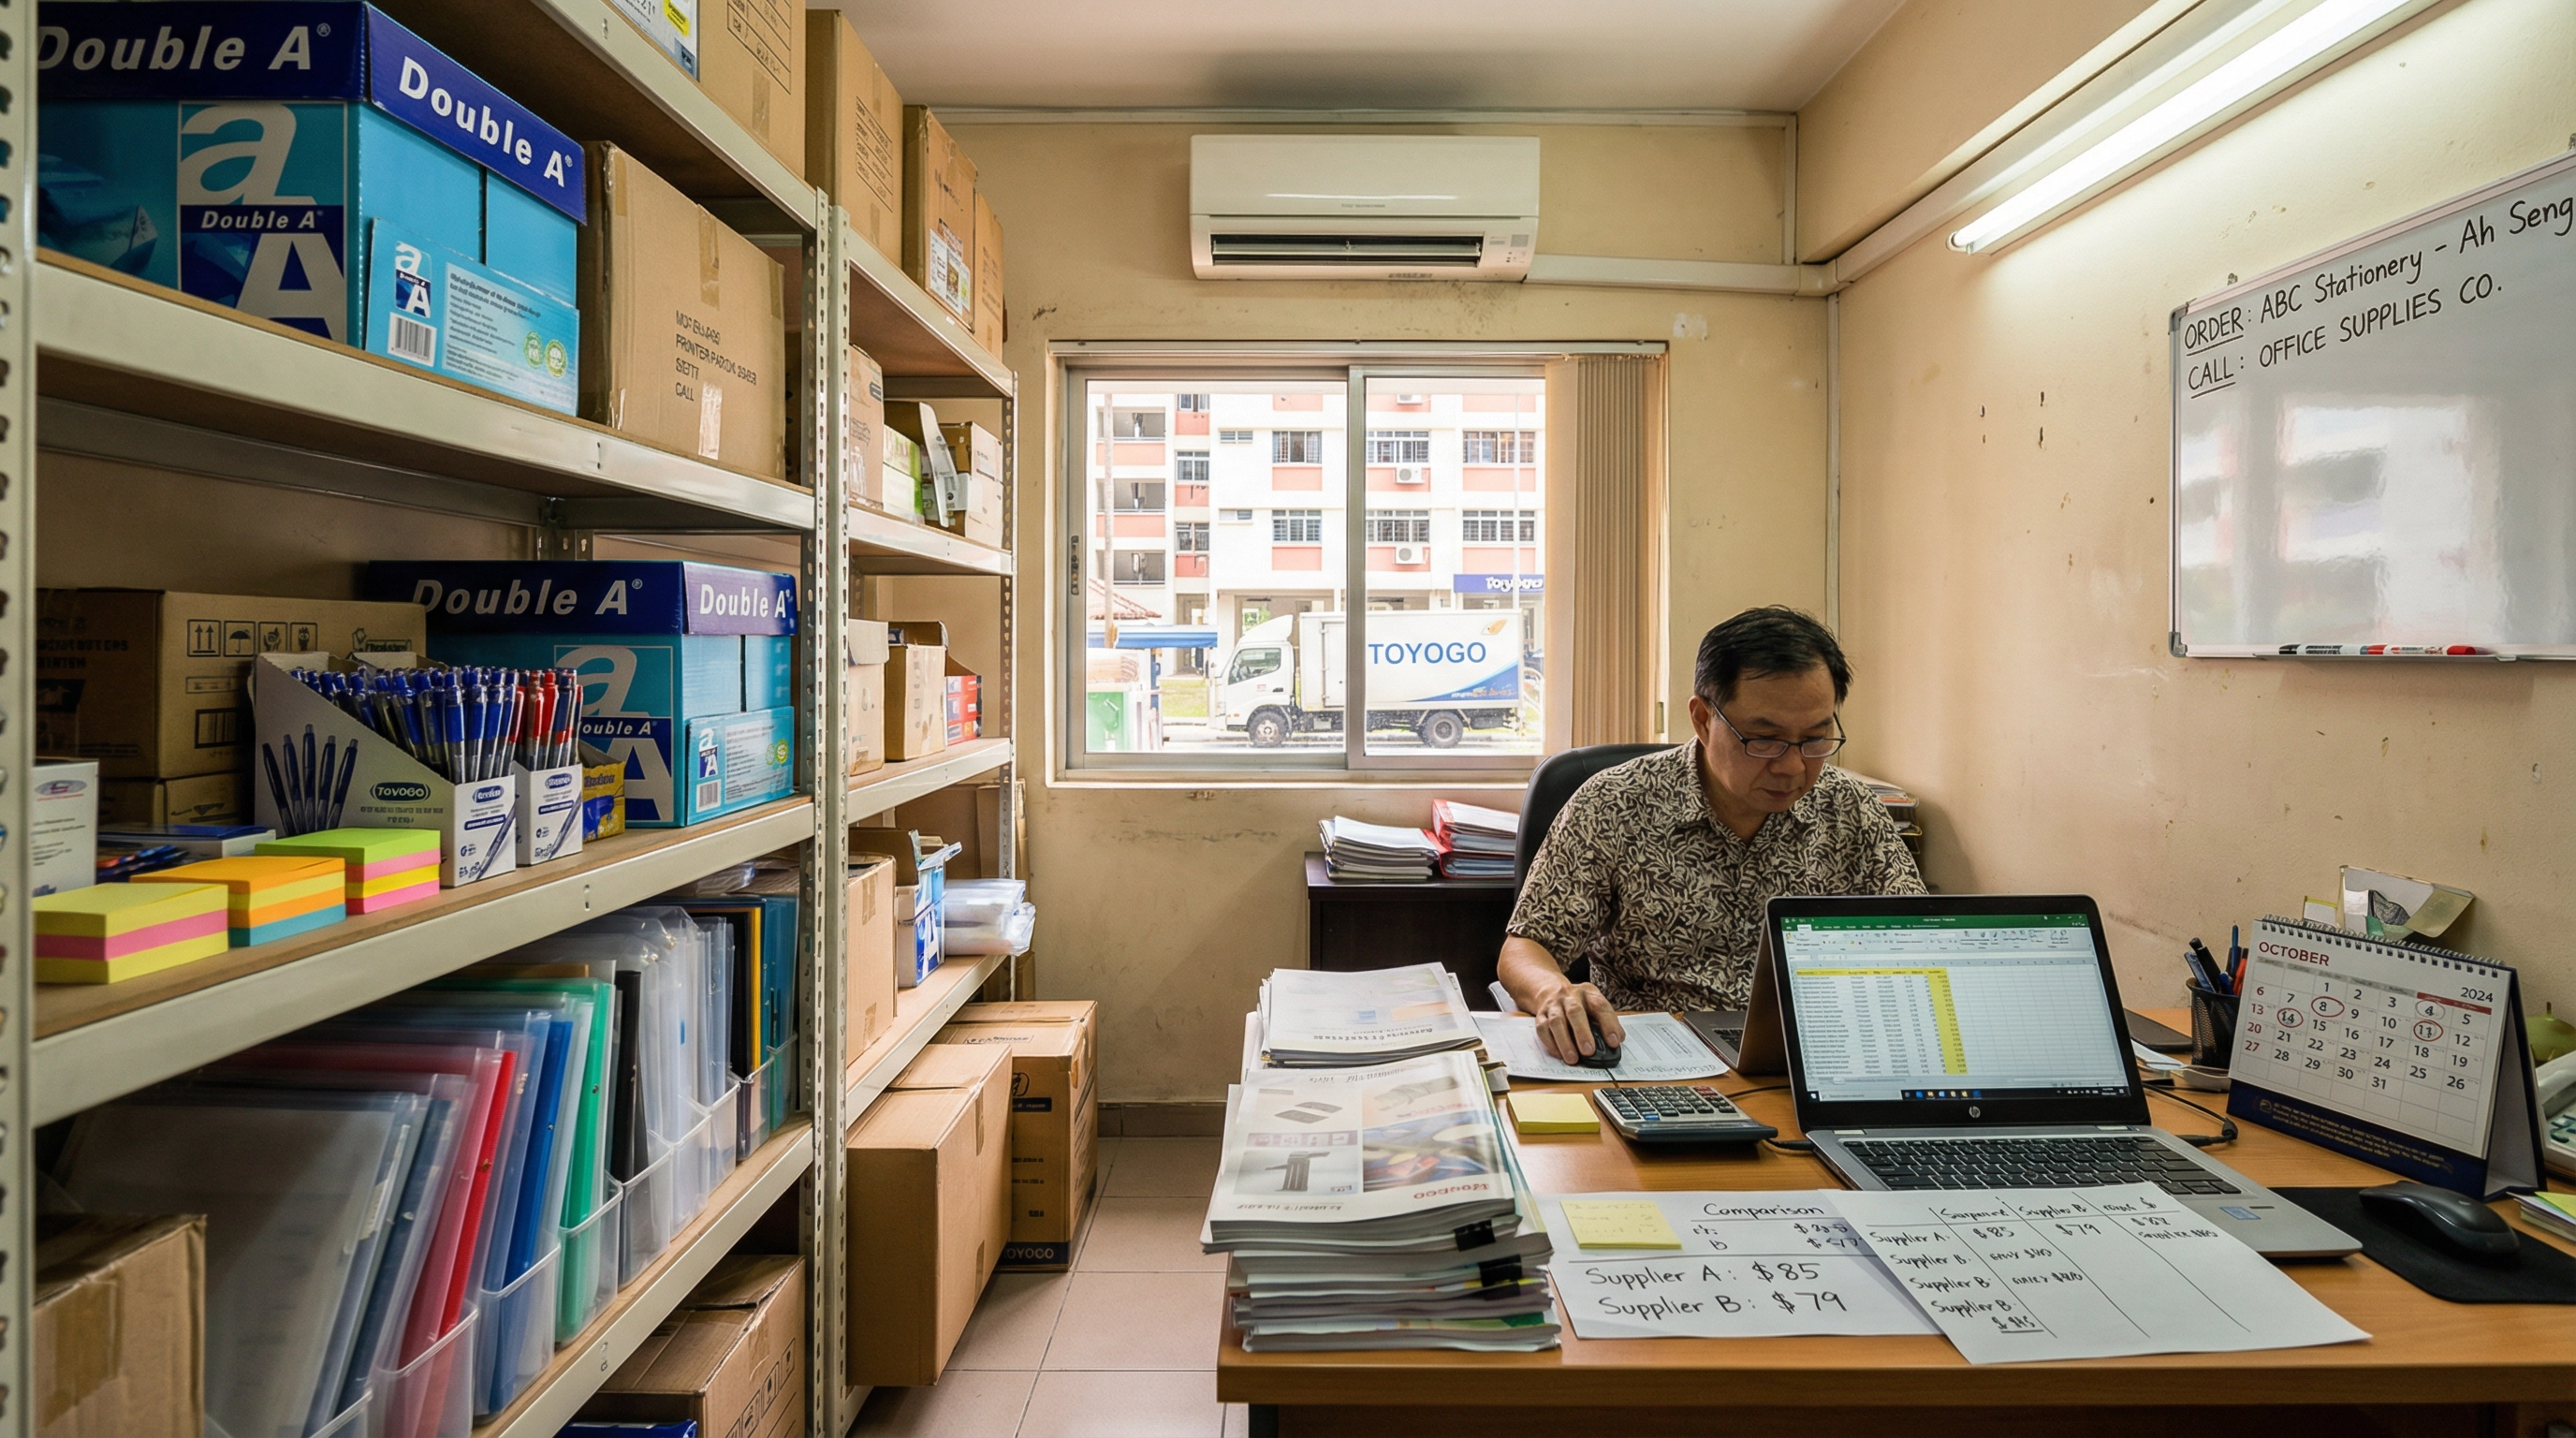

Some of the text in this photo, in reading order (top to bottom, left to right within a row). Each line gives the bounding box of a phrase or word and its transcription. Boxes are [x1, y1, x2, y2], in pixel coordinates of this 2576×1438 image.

[37, 26, 245, 70] Double
[400, 56, 532, 165] Double
[200, 211, 288, 229] Double
[2261, 285, 2302, 323] ABC
[2314, 251, 2422, 303] Stationery
[2460, 215, 2494, 254] Ah
[2510, 198, 2573, 236] Seng
[2260, 326, 2326, 367] OFFICE
[2339, 288, 2441, 342] SUPPLIES
[2459, 273, 2502, 304] CO.
[413, 580, 578, 615] Double
[699, 584, 768, 618] Double
[1368, 641, 1486, 665] TOYOGO
[580, 721, 634, 735] ouble
[2259, 942, 2330, 966] OCTOBER
[2324, 983, 2329, 992] 1
[2353, 990, 2362, 1000] 2
[2388, 997, 2396, 1007] 3
[2462, 1014, 2471, 1025] 5
[2460, 987, 2494, 1003] 2024
[2257, 987, 2264, 996] 6
[2287, 993, 2295, 1003] 7
[2319, 1002, 2327, 1012] 8
[2351, 1009, 2359, 1019] 9
[2381, 1017, 2396, 1029] 10
[2455, 1034, 2470, 1047] 12
[2251, 1004, 2264, 1015] 13
[2313, 1020, 2327, 1032] 15
[2345, 1028, 2359, 1040] 16
[2379, 1036, 2394, 1049] 17
[2414, 1046, 2429, 1058] 18
[2452, 1055, 2467, 1067] 19
[2245, 1040, 2386, 1090] 27 28 29 30 31
[2247, 1022, 2465, 1090] 20 21 22 23 24 25 26
[1704, 1203, 1824, 1220] Comparison
[1869, 1232, 1928, 1246] Supplier
[1586, 1267, 1685, 1290] Supplier
[1751, 1261, 1820, 1284] $85
[1890, 1254, 1948, 1269] Supplier
[1909, 1277, 1970, 1293] Supplier
[1599, 1297, 1704, 1321] Supplier
[1771, 1291, 1848, 1314] $79
[1931, 1299, 1993, 1317] Supplier
